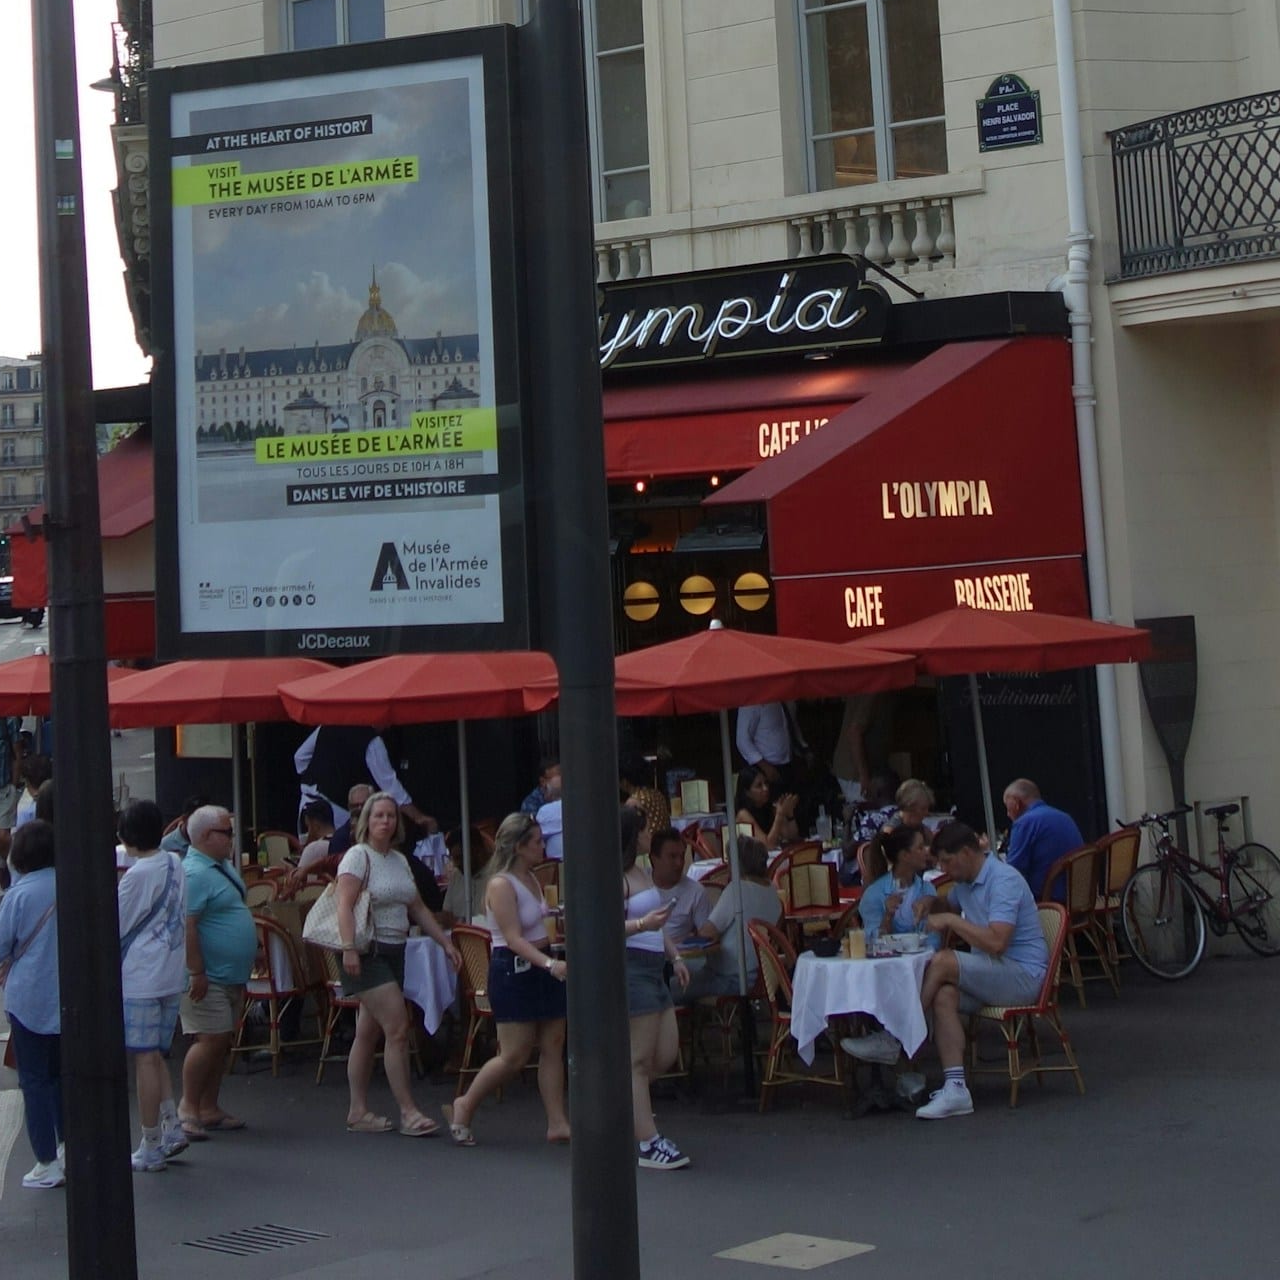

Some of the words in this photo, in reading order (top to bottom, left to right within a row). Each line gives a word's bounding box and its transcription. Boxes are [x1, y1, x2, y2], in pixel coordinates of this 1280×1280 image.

[997, 102, 1019, 113] PLACE
[982, 117, 1001, 127] HENRI
[1002, 111, 1036, 124] SALVADOR
[206, 137, 221, 150] AT
[221, 133, 248, 148] THE
[250, 129, 292, 146] HEART
[294, 126, 312, 140] OF
[315, 120, 368, 137] HISTORY
[208, 166, 237, 179] VISIT
[209, 181, 242, 199] THE
[247, 170, 306, 195] MUSÉE
[312, 171, 334, 188] DE
[339, 158, 414, 185] L'ARMÉE
[208, 206, 242, 220] EVERY
[246, 204, 268, 217] DAY
[270, 201, 302, 214] FROM
[305, 197, 333, 210] 10AM
[336, 195, 351, 207] TO
[352, 192, 375, 205] 6PM
[600, 271, 865, 365] ympia
[416, 415, 463, 430] VISITEZ
[267, 443, 285, 459] LE
[291, 434, 351, 457] MUSÉE
[358, 437, 381, 453] DE
[387, 427, 463, 452] L'ARMÉE
[297, 467, 327, 479] TOUS
[330, 465, 349, 477] LES
[351, 463, 389, 476] JOURS
[393, 461, 408, 473] DE
[411, 460, 430, 472] 10H
[445, 458, 464, 470] 18H
[293, 488, 328, 502] DANS
[332, 486, 347, 500] LE
[349, 485, 370, 498] VIF
[374, 484, 392, 497] DE
[395, 480, 466, 496] L'HISTOIRE
[881, 479, 993, 519] L'OLYMPIA
[403, 539, 451, 555] Musée
[408, 558, 426, 572] de
[430, 555, 488, 572] l'Armée
[414, 574, 481, 590] Invalides
[954, 573, 1034, 612] BRASSERIE
[844, 586, 885, 628] CAFE
[298, 634, 370, 650] JCDecaux
